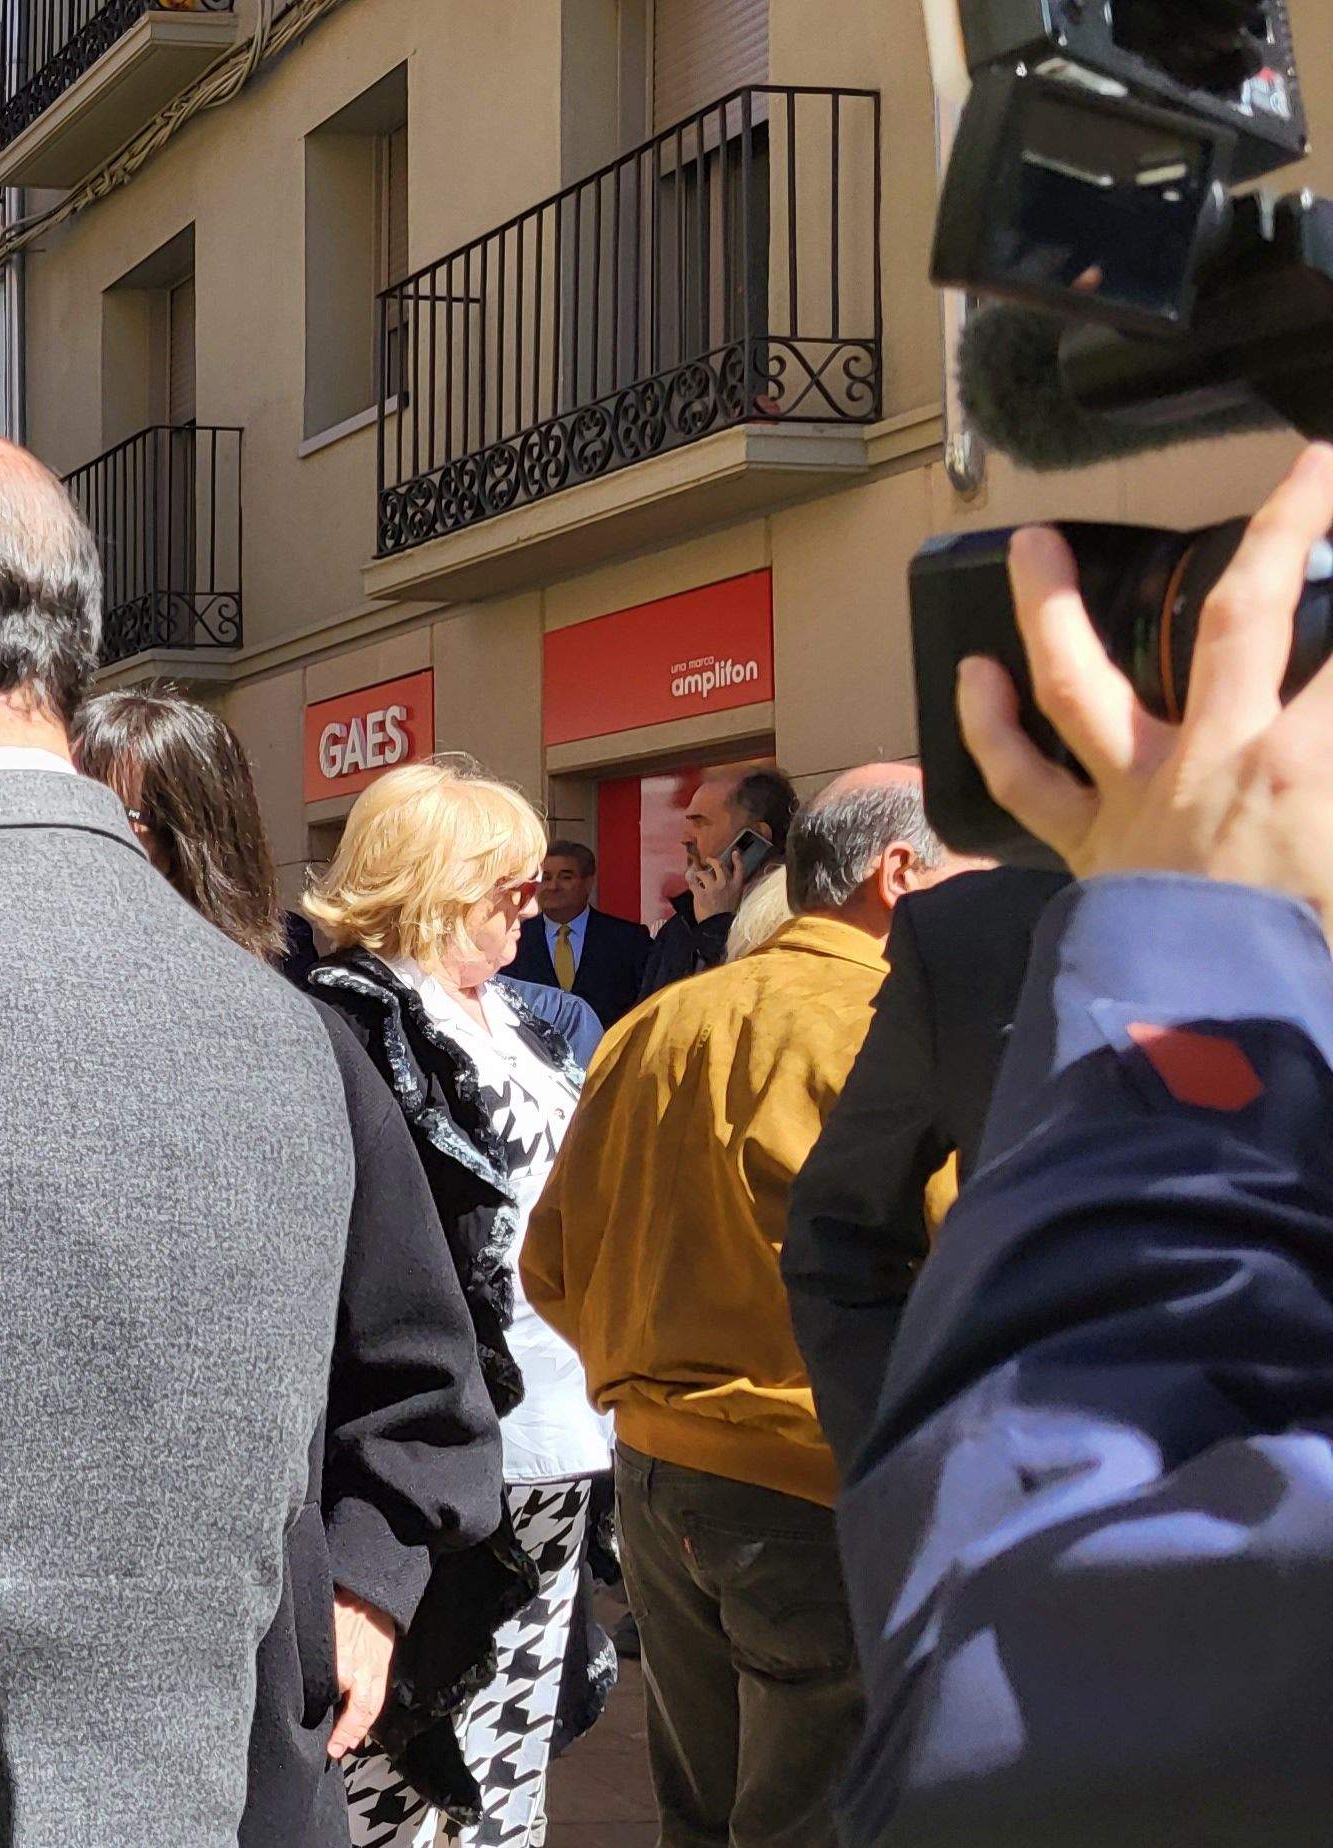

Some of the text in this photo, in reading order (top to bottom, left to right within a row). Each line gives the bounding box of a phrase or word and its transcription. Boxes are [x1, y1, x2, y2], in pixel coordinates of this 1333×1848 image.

[671, 656, 714, 673] una marca
[671, 658, 758, 698] amplifon
[319, 705, 408, 778] GAES
